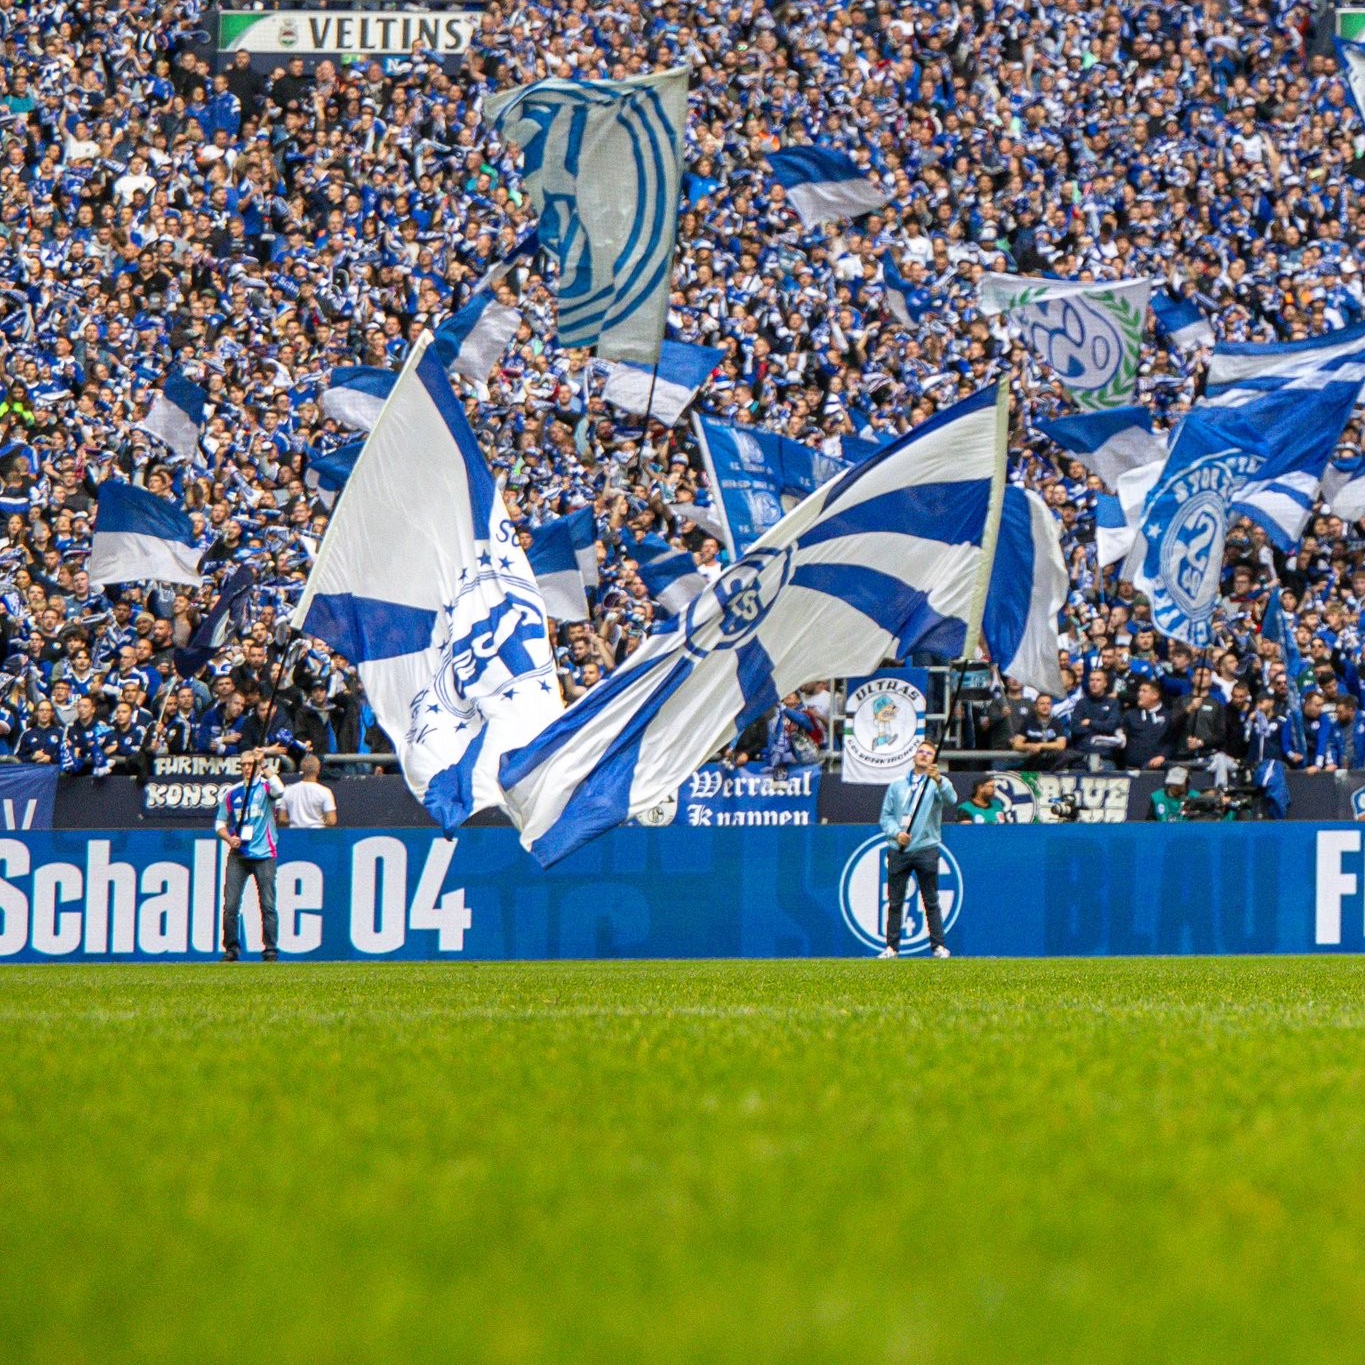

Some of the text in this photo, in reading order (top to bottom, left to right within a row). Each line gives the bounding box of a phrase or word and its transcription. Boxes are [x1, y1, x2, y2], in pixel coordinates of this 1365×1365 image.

[309, 18, 463, 50] VELTINS
[855, 680, 920, 701] ULTRAS
[1037, 775, 1131, 809] BLUE
[350, 835, 472, 954] 04
